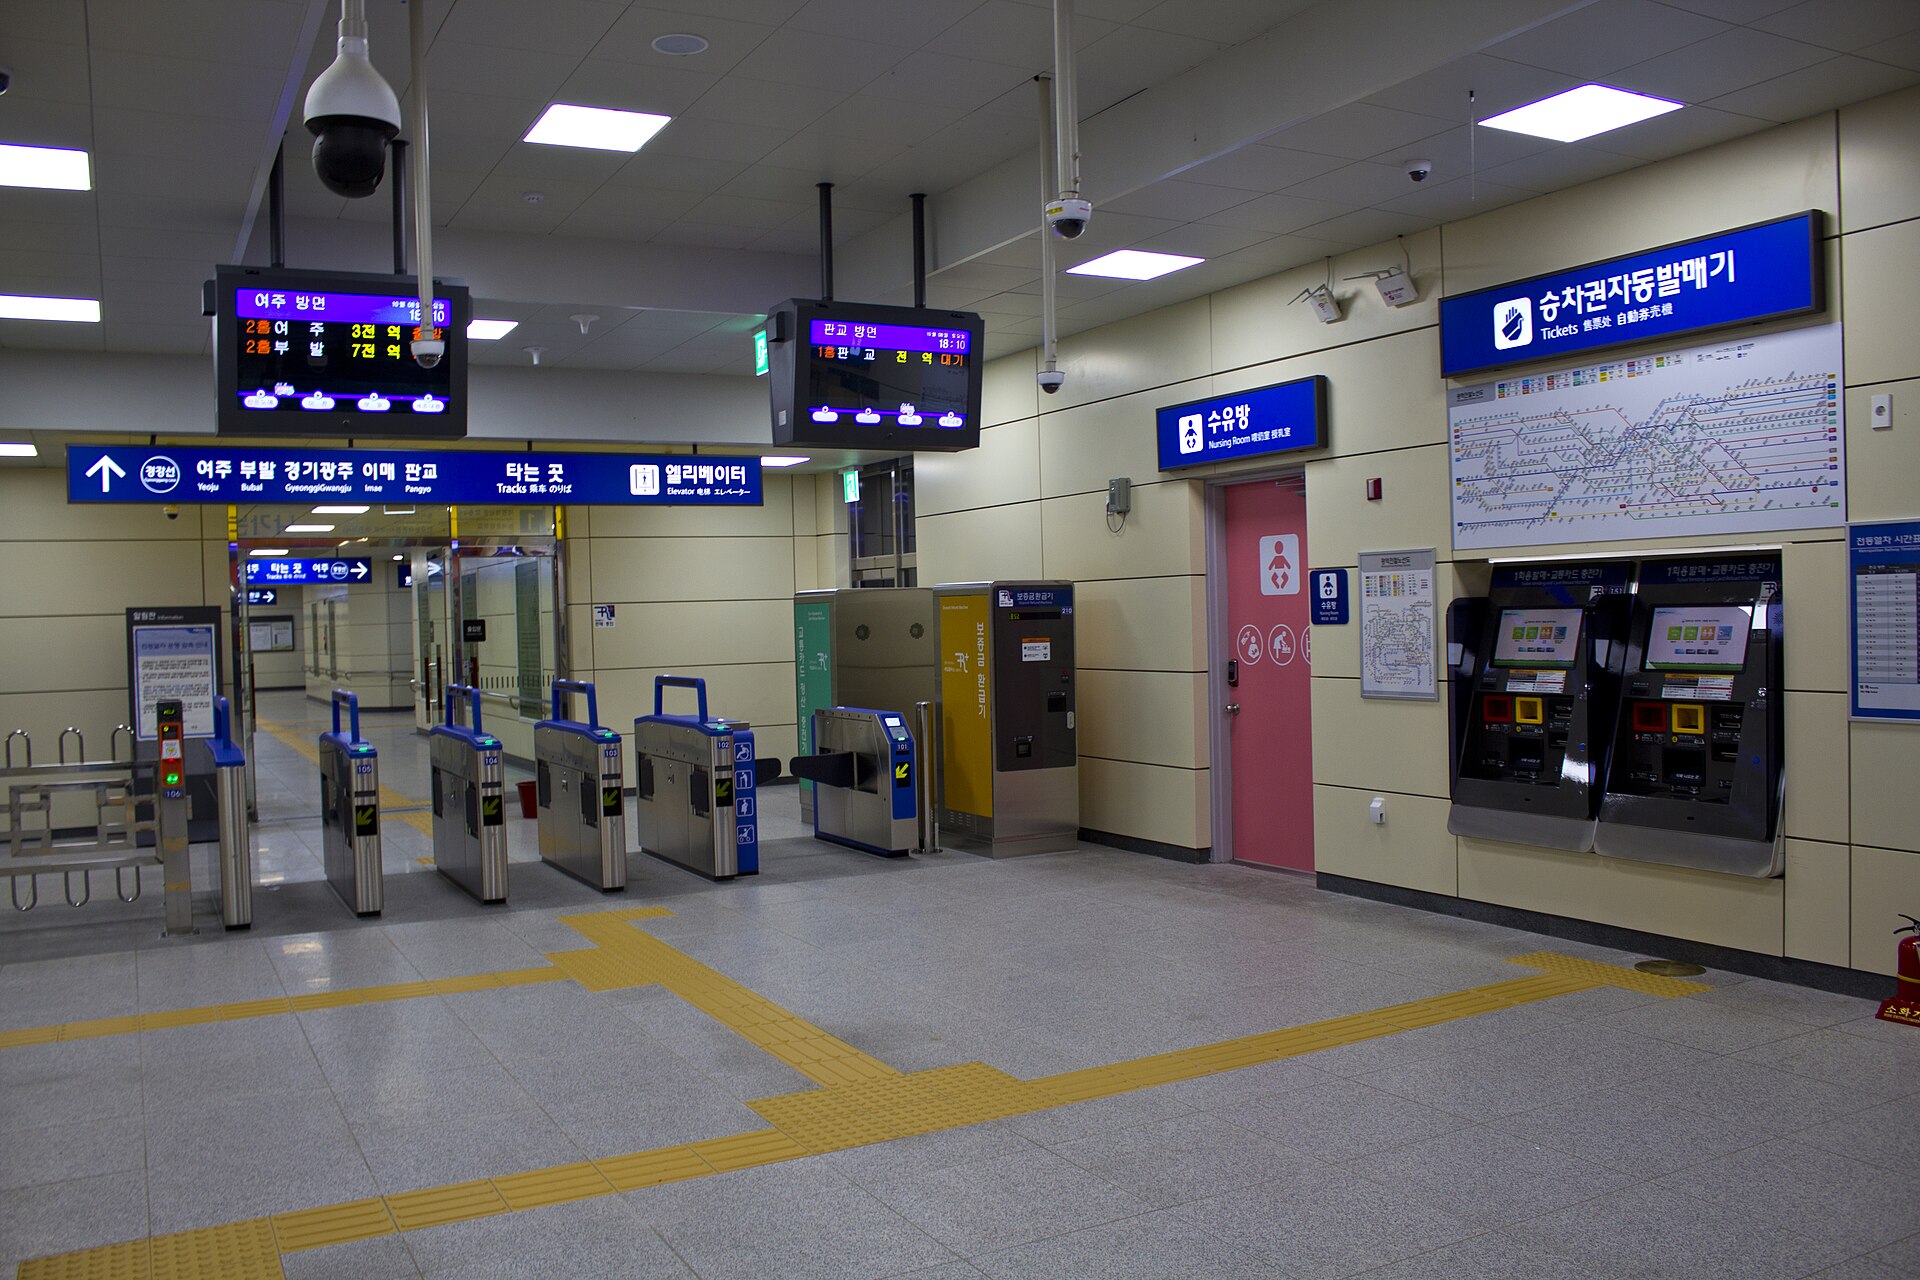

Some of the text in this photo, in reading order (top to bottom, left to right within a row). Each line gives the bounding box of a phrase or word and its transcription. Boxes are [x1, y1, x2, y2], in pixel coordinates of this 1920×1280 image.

[1539, 249, 1736, 322] 승차권자동발매기
[254, 293, 326, 311] 여주 방면
[824, 323, 877, 338] 판교 방면
[1541, 323, 1578, 340] Tickets
[940, 353, 963, 367] 대기
[1208, 404, 1251, 434] 수유방
[1208, 438, 1232, 449] Nursing
[1232, 436, 1251, 446] Room
[145, 465, 176, 478] 경강선
[196, 460, 438, 481] 여주 부발 경기광주 이매 판교
[506, 462, 564, 483] 타는 곳
[665, 464, 746, 485] 엘리베이터
[197, 482, 220, 493] Yeoju
[241, 483, 263, 492] Bubal
[364, 484, 383, 493] Imae
[405, 485, 432, 495] Pangyo
[496, 482, 527, 494] Tracks
[667, 487, 695, 496] Elevator
[1856, 535, 1892, 546] 전동열차
[1016, 592, 1054, 601] 보증금환급기
[1321, 601, 1337, 610] 수유방
[976, 621, 986, 720] 보증금 환급기
[717, 741, 730, 749] 102
[897, 743, 908, 751] 101
[605, 749, 618, 758] 103
[166, 789, 181, 798] 106
